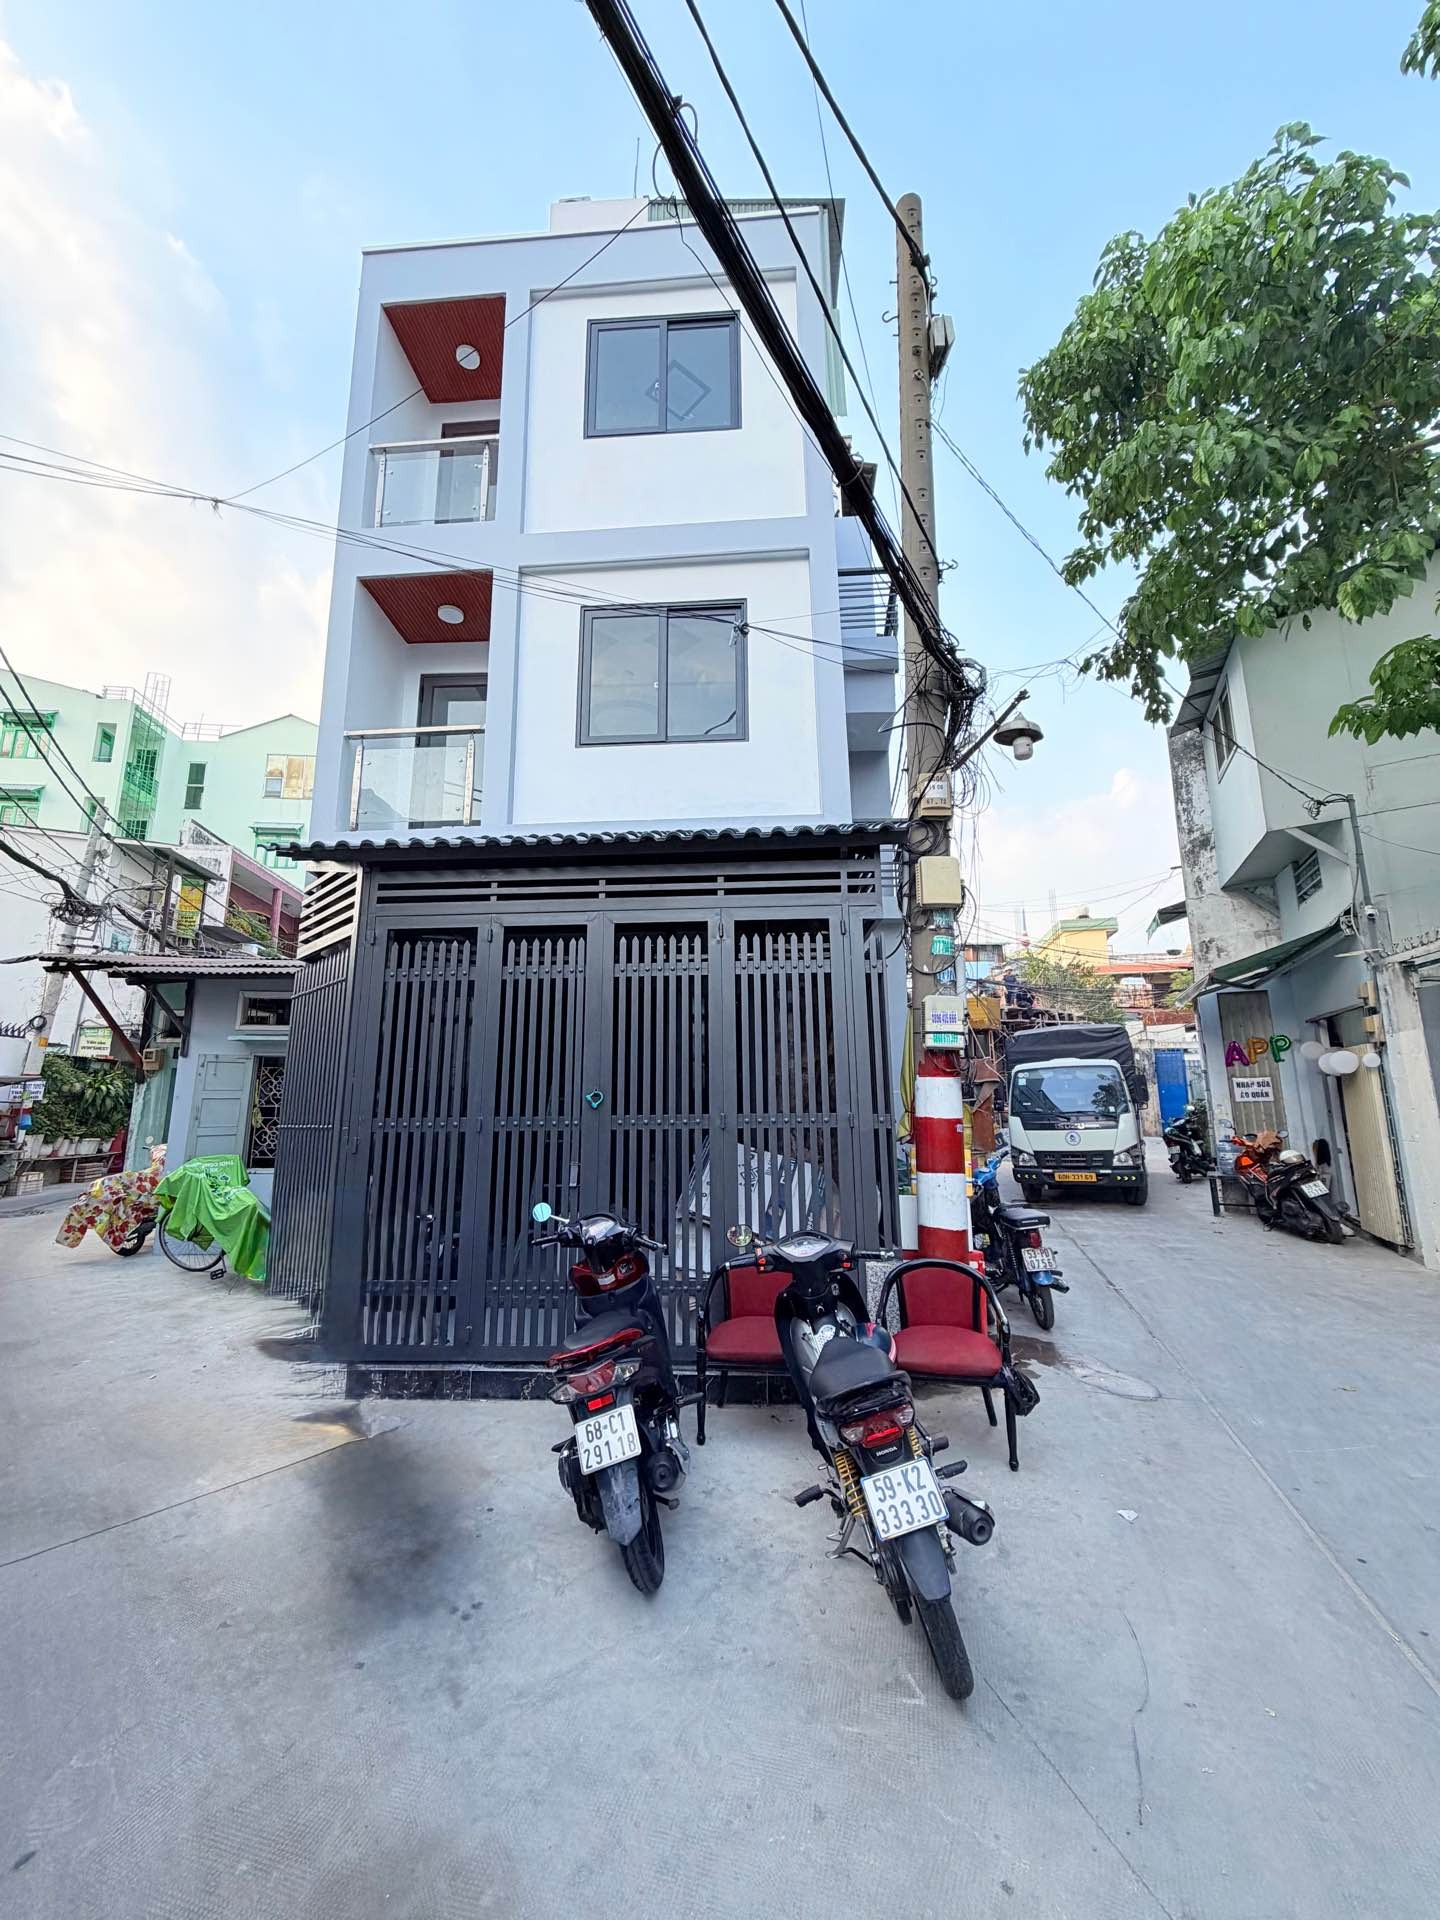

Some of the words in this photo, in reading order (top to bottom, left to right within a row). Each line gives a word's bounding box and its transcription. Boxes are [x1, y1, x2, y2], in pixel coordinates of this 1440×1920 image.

[585, 1412, 626, 1444] 68-C1
[583, 1432, 637, 1470] 291.18
[876, 1446, 898, 1457] HONDA
[873, 1465, 927, 1503] 59-K2
[876, 1491, 943, 1534] 333.30
